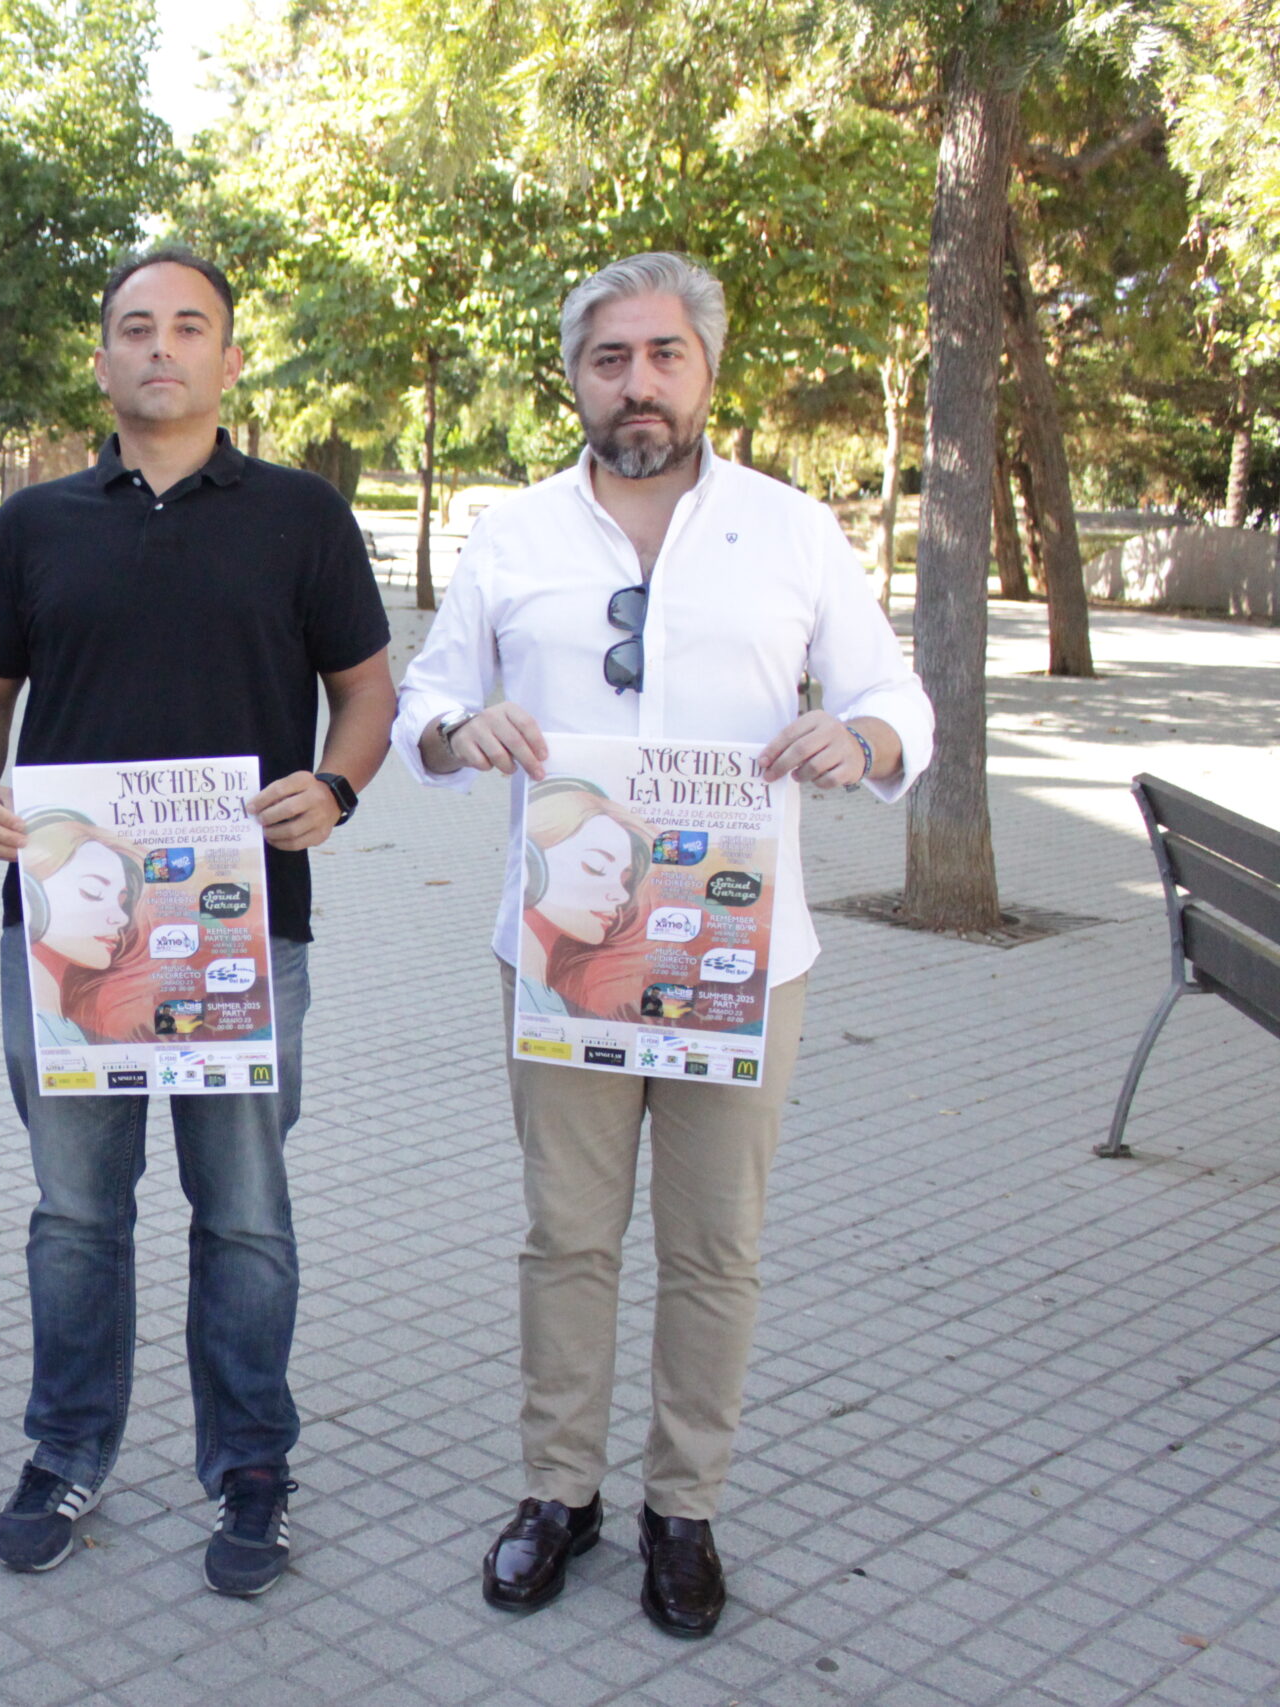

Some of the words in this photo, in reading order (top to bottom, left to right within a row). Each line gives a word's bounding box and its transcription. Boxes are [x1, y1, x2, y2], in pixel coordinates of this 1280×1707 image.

[637, 746, 742, 780] NOCHES
[116, 766, 216, 798] NOCHES
[221, 770, 247, 790] DE
[625, 776, 662, 805] LA
[668, 778, 773, 811] DEHESA
[109, 799, 144, 827] LA
[150, 794, 248, 825] DEHESA
[630, 806, 648, 815] DEL
[664, 808, 674, 816] AL
[705, 810, 747, 820] AGOSTO
[644, 816, 689, 826] JARDINES
[692, 819, 705, 827] DE
[707, 820, 725, 828] LAS
[726, 821, 760, 830] LETRAS
[117, 829, 134, 837] DEL
[188, 825, 227, 833] AGOSTO
[229, 824, 251, 832] 2025
[132, 836, 174, 845] JARDINES
[191, 835, 208, 843] LAS
[209, 834, 241, 842] LETRAS
[710, 877, 751, 889] Sound
[202, 890, 240, 900] Sound
[711, 886, 757, 901] Garage
[204, 899, 247, 911] Garage
[709, 914, 754, 924] REMEMBER
[706, 921, 732, 930] PARTY
[658, 955, 697, 965] DIRECTO
[164, 971, 201, 979] DIRECTO
[698, 991, 735, 1001] SUMMER
[736, 994, 755, 1003] 2025
[207, 1002, 241, 1010] SUMMER
[713, 1000, 739, 1008] PARTY
